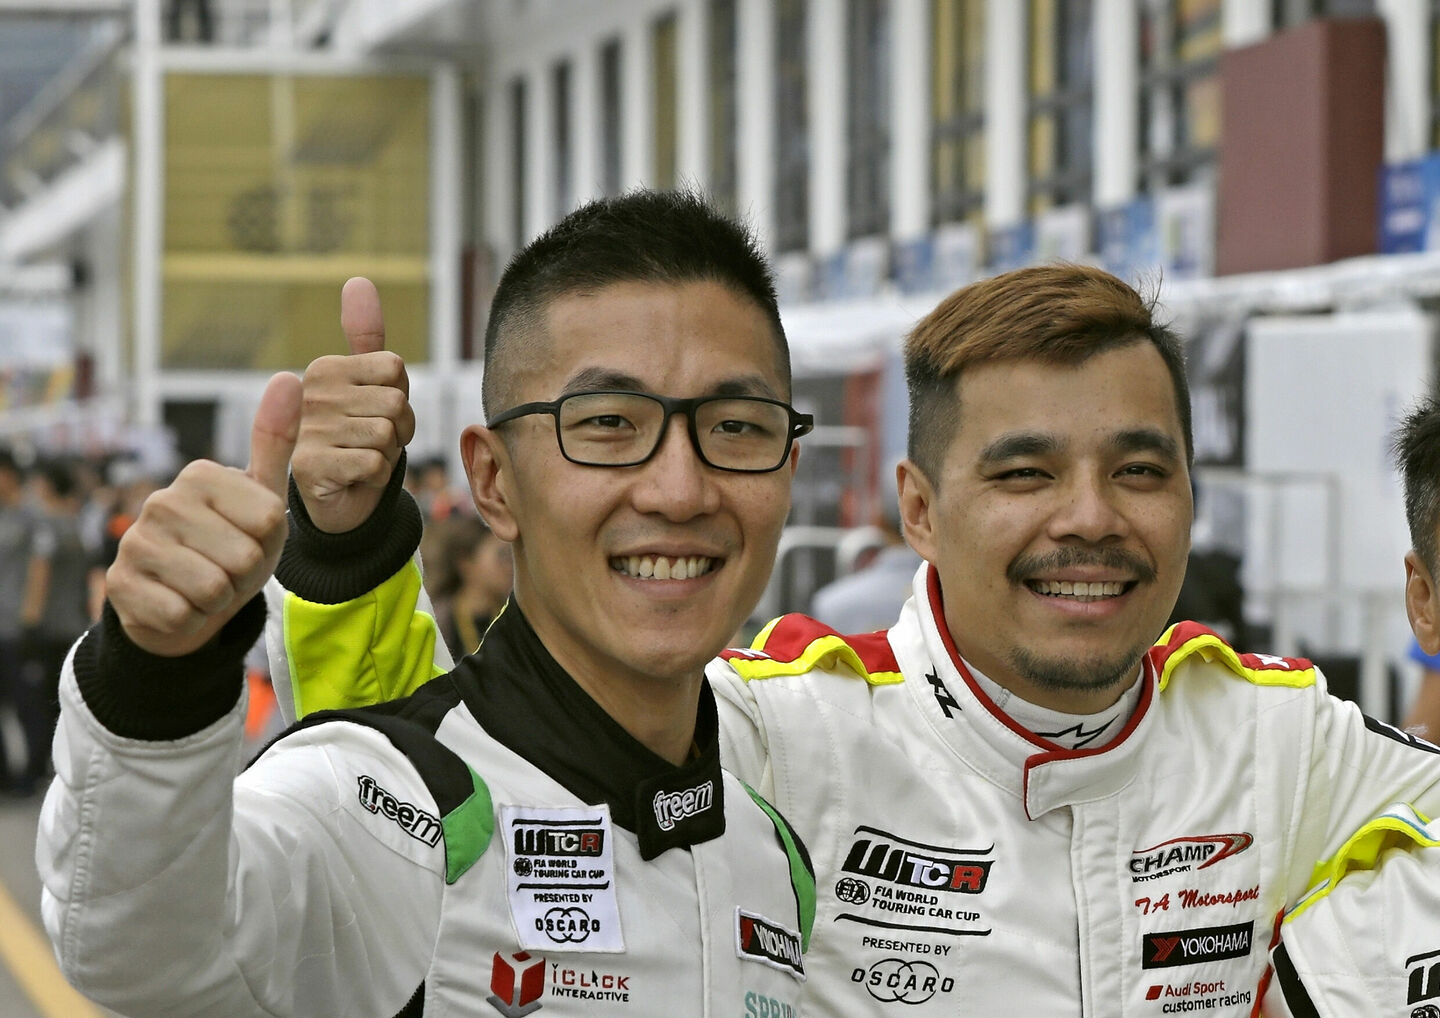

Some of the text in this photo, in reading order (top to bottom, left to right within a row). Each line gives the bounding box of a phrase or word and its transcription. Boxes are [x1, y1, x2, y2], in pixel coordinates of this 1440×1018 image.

[358, 775, 442, 848] freem
[653, 780, 713, 831] freem
[548, 860, 577, 868] WORLD
[841, 839, 996, 894] WTCR
[1129, 844, 1215, 874] CHAMP
[534, 870, 605, 879] TOURING CAR CUP
[1132, 865, 1191, 883] MOTORSPORT
[534, 893, 593, 902] PRESENTED BY
[874, 886, 938, 905] FIA WORLD
[872, 898, 980, 922] TOURING CAR CUP
[535, 918, 601, 932] OSCARO
[862, 936, 951, 956] PRESENTED BY
[1180, 931, 1249, 957] YOKOHAMA
[851, 968, 955, 993] OSCARO
[1165, 980, 1225, 998] Audi Sport
[552, 987, 629, 1002] INTERACTIVE
[1162, 990, 1251, 1014] customer racing
